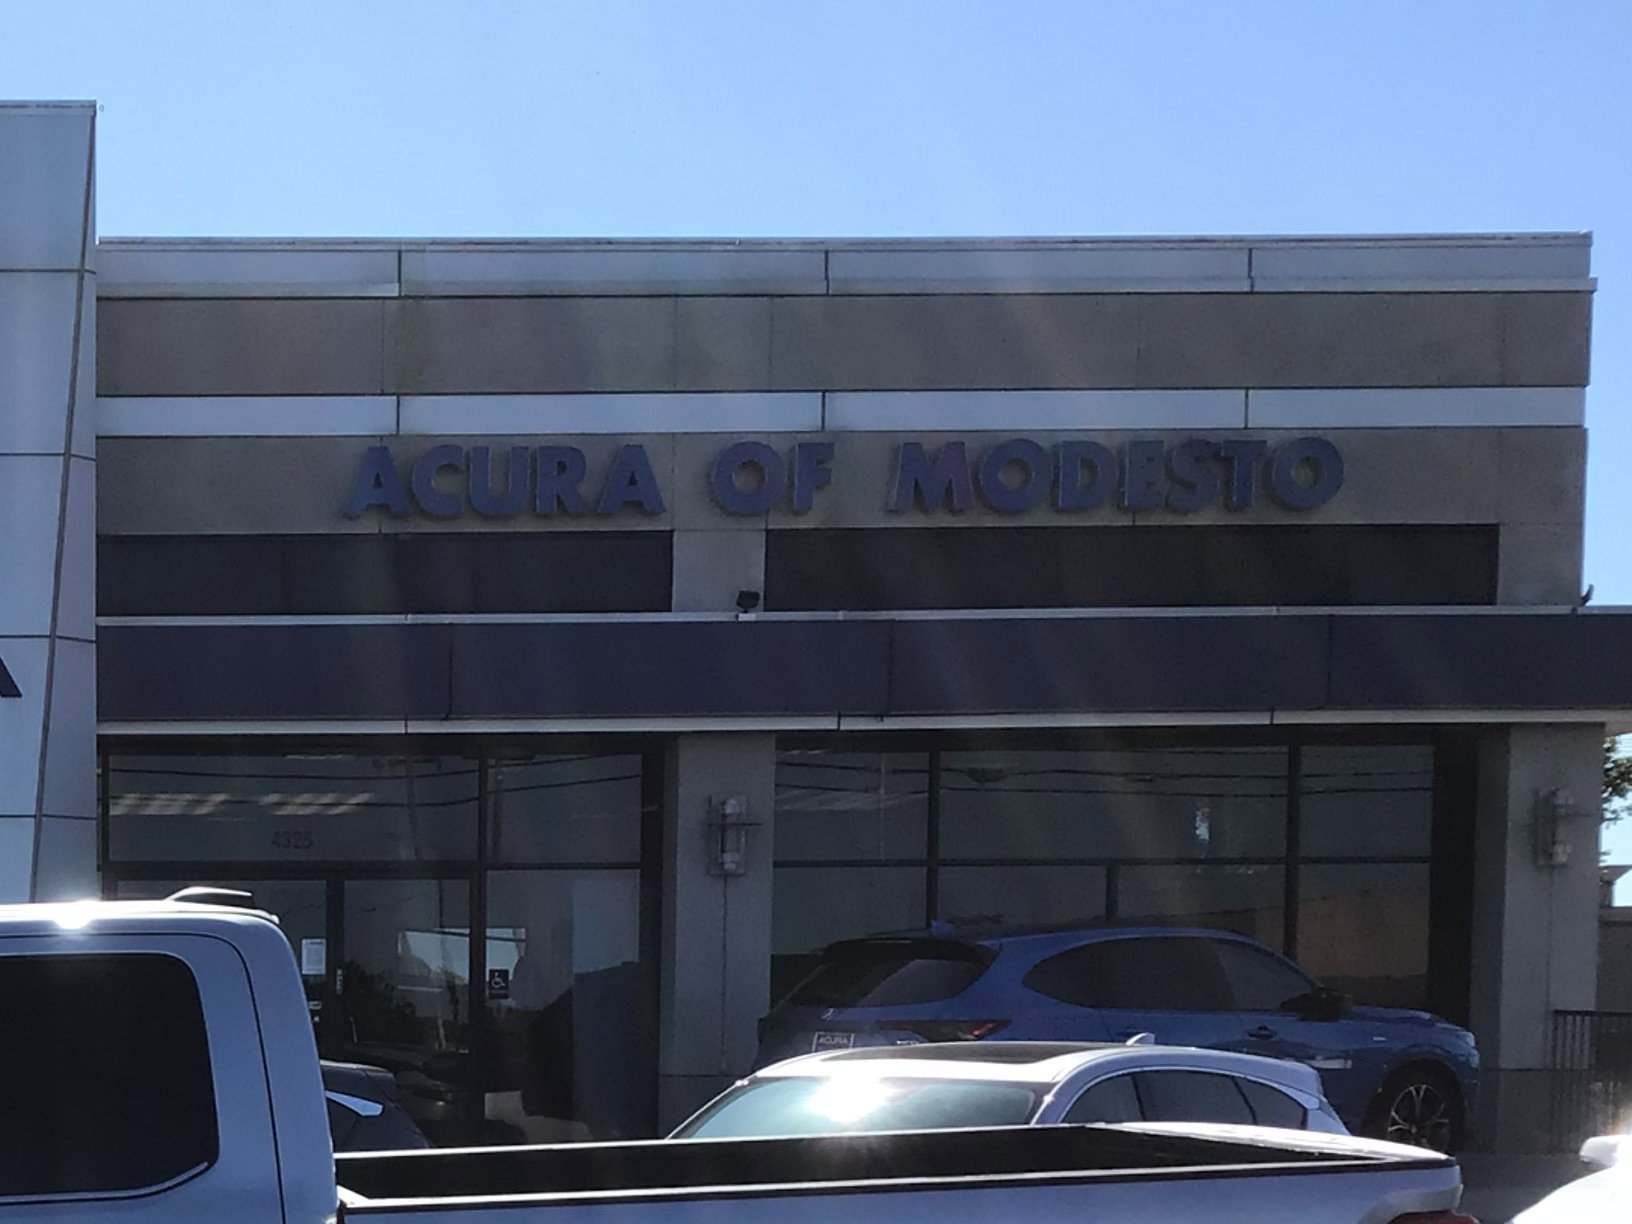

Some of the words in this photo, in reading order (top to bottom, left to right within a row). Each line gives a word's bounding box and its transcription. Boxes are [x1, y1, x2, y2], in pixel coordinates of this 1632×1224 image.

[342, 443, 665, 517] ACURA
[712, 440, 835, 516] OF
[883, 437, 1344, 513] MODESTO
